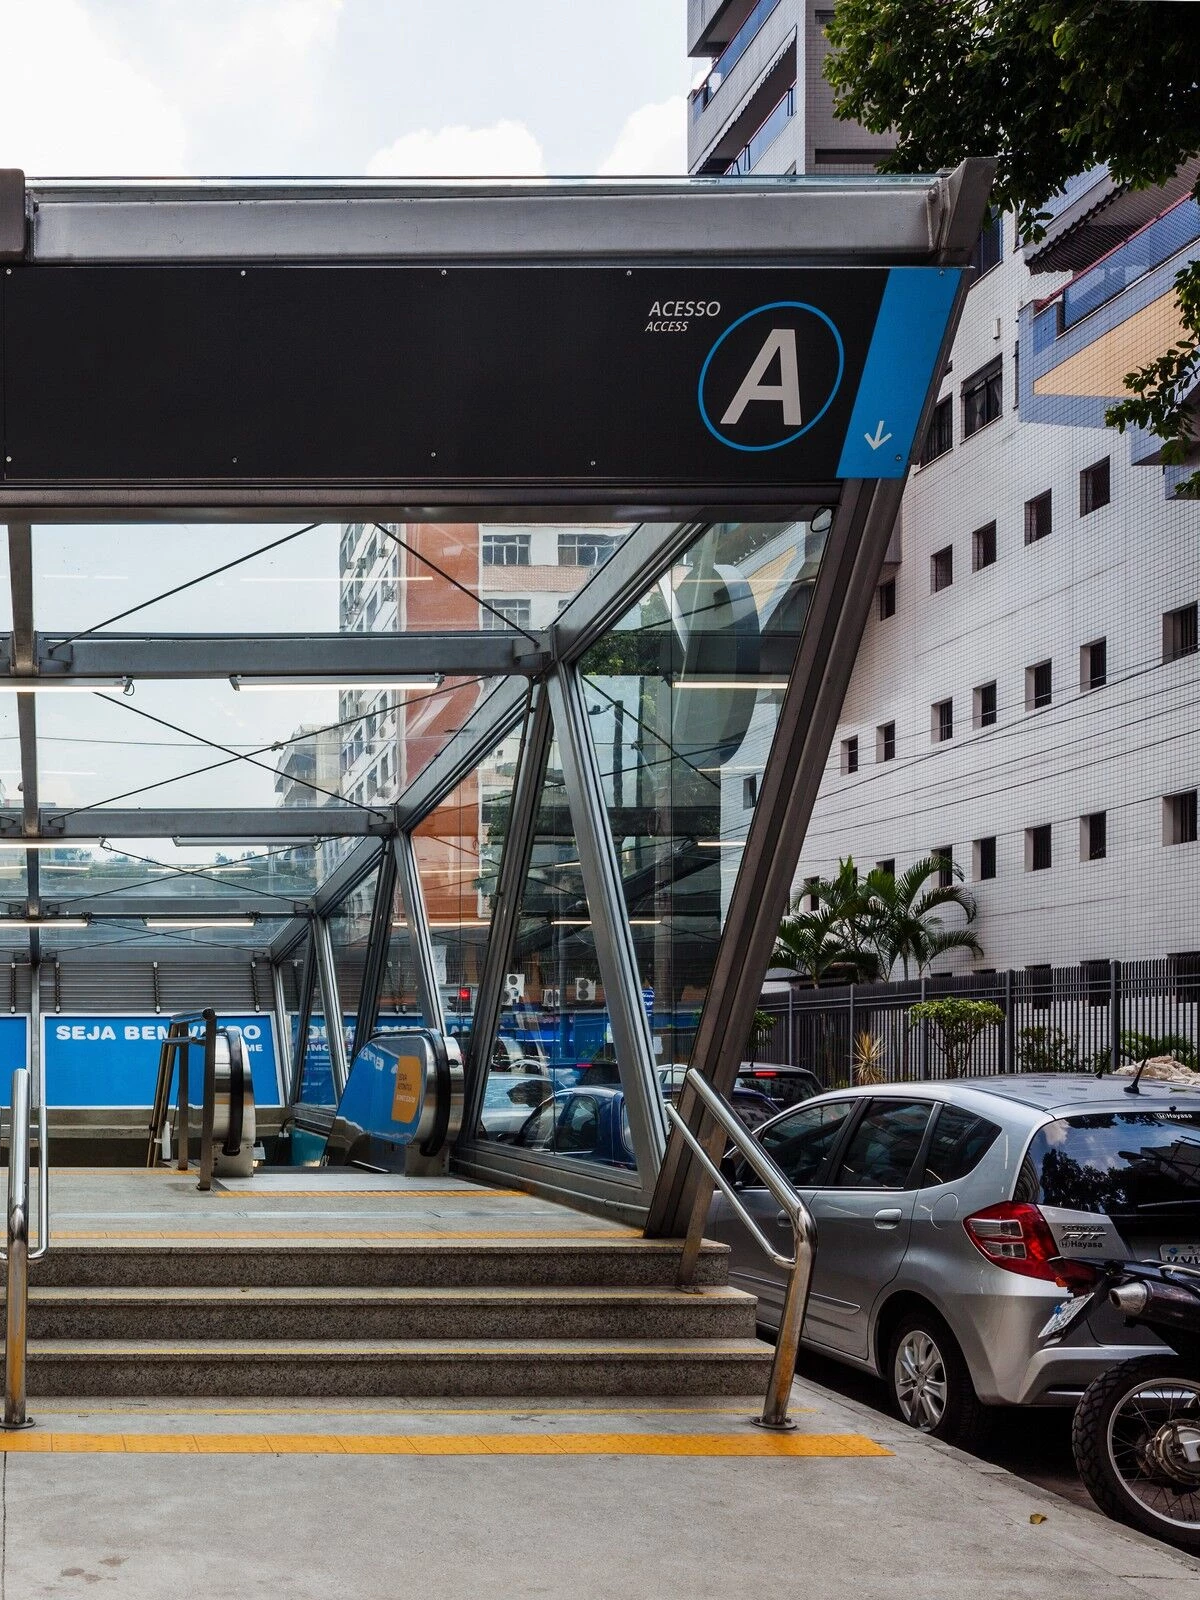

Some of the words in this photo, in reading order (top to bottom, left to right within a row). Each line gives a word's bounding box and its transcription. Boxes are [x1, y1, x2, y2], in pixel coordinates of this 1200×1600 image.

[648, 300, 721, 318] ACESSO
[645, 321, 688, 332] ACCESS
[720, 328, 802, 426] A
[56, 1025, 116, 1041] SEJA
[1071, 1241, 1103, 1249] Hayasa
